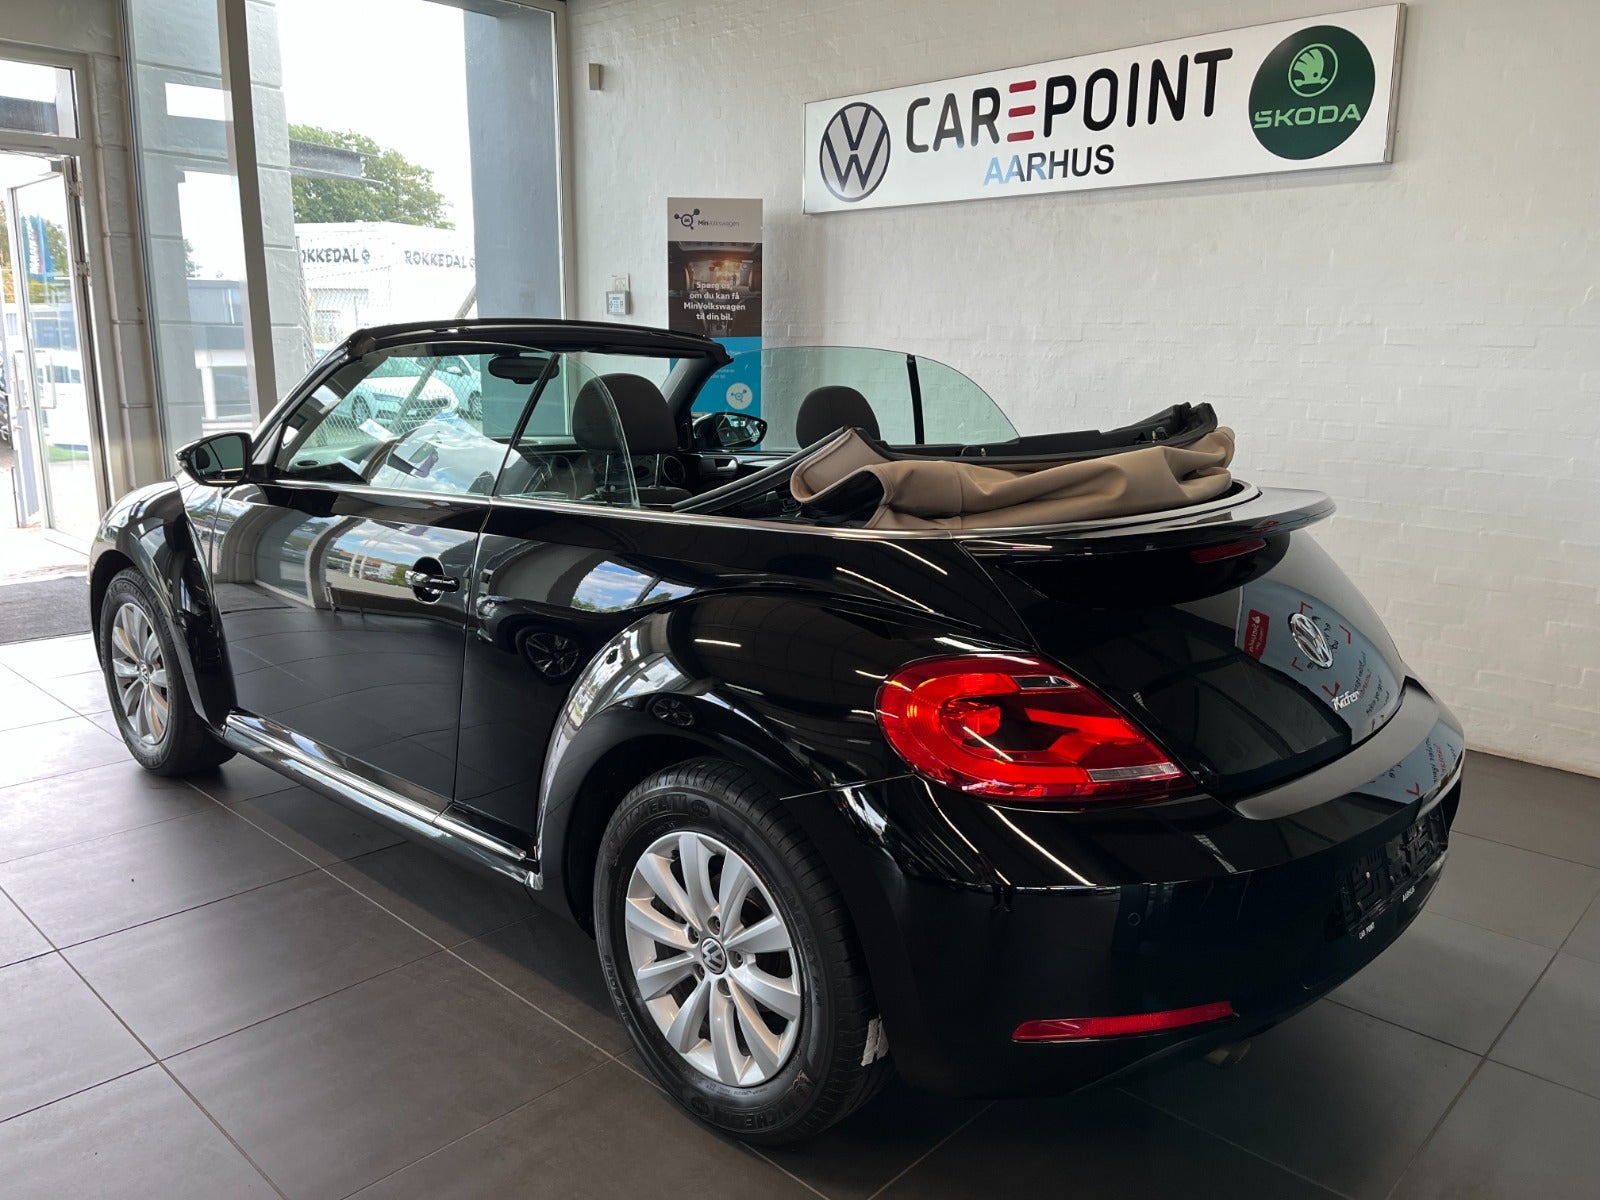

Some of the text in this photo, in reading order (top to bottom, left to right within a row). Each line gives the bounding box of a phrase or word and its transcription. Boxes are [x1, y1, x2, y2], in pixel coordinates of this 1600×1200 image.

[905, 47, 1233, 154] CAREPOINT
[983, 144, 1115, 187] AARHUS
[404, 250, 467, 269] ROKKEDAL
[731, 291, 740, 300] få
[683, 302, 746, 311] MinVolkswagen
[720, 313, 733, 321] bil.
